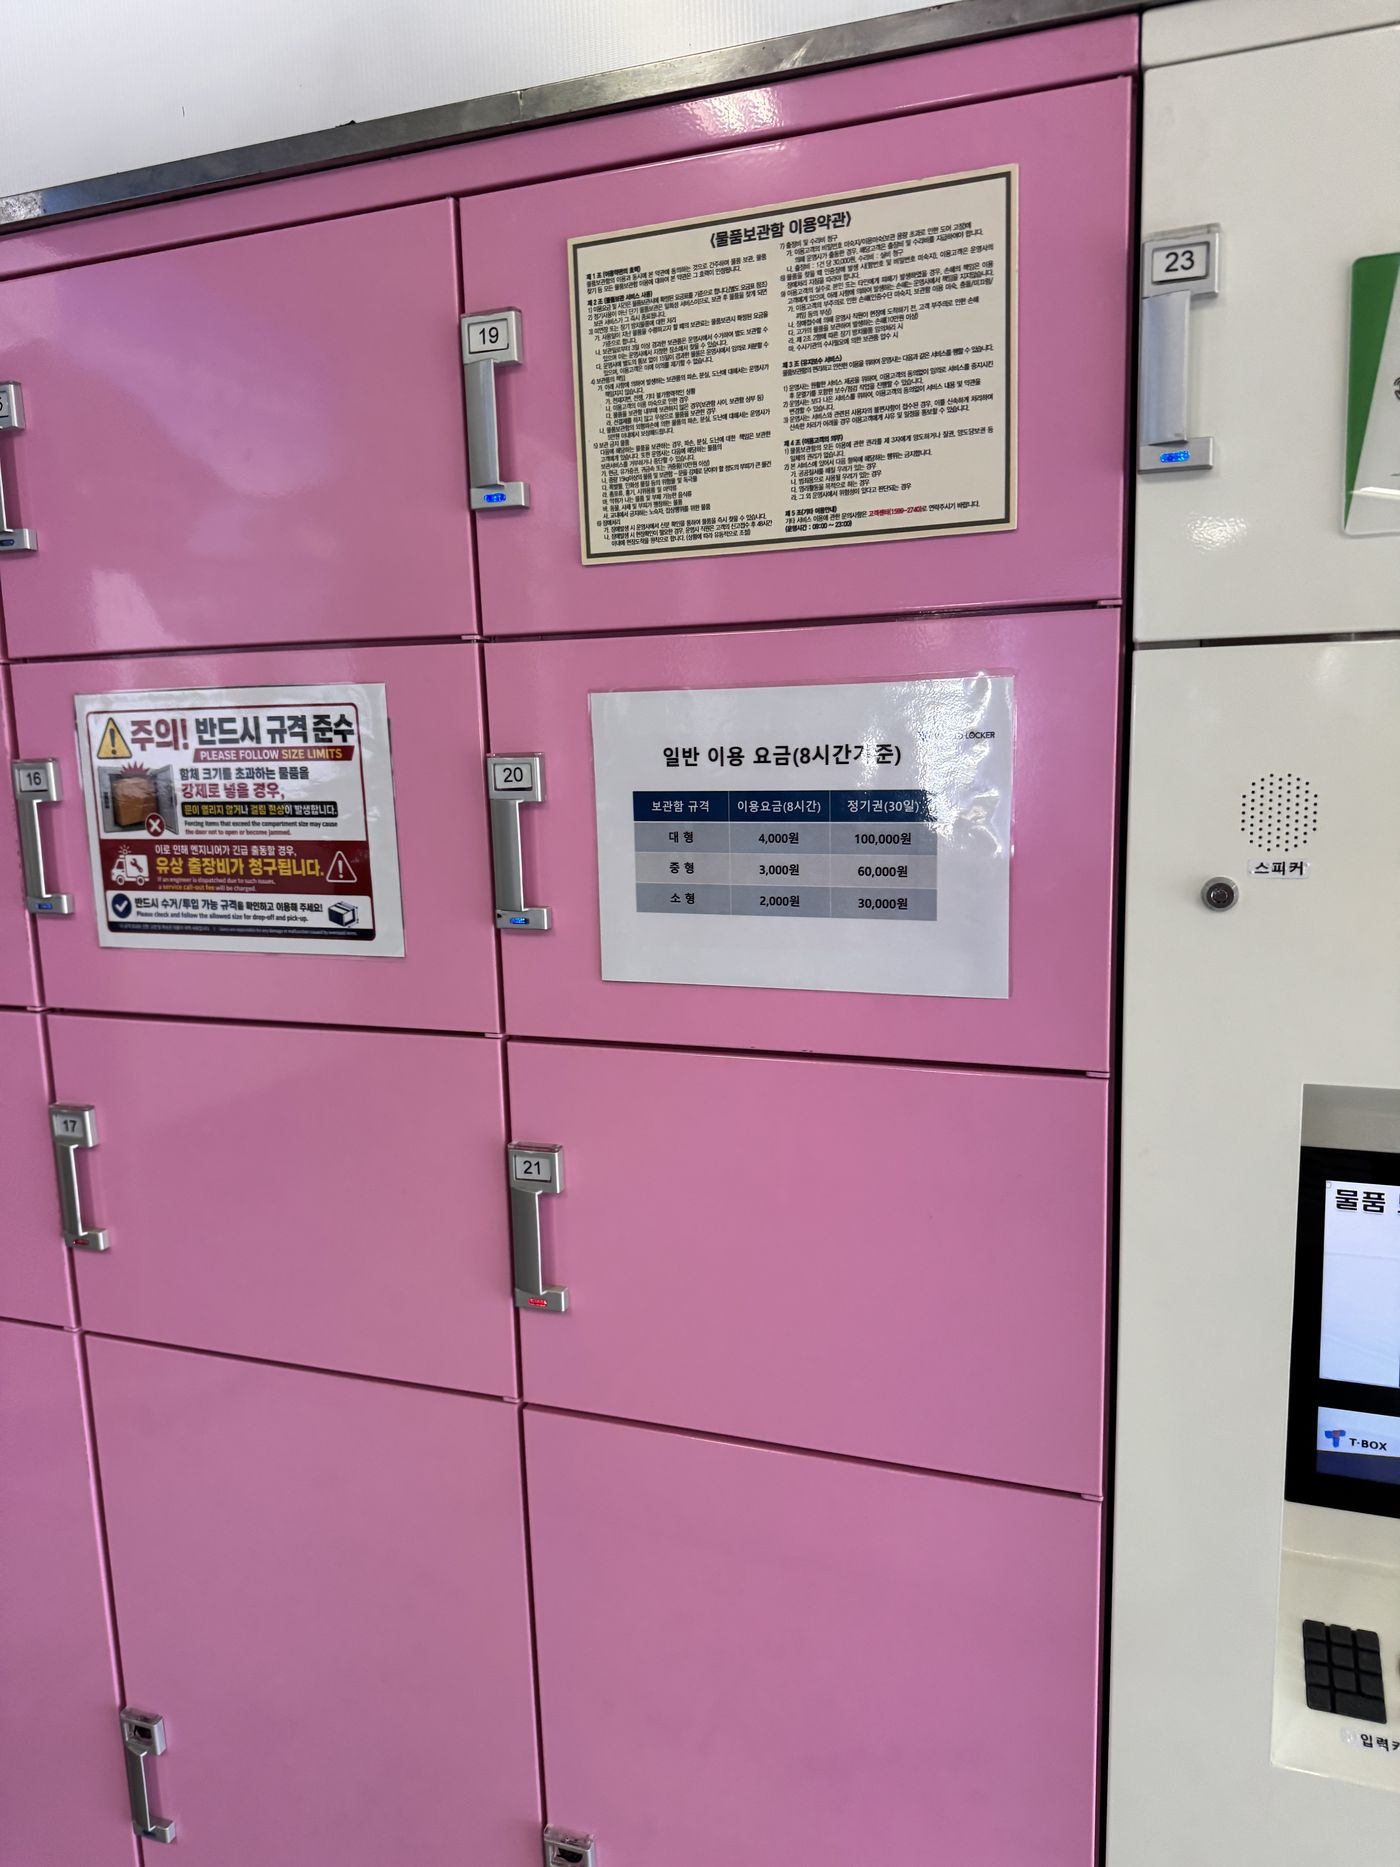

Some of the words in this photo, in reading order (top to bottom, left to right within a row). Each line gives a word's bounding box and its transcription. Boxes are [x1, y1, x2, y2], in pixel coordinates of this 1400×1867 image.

[1165, 250, 1195, 272] 23
[480, 326, 499, 346] 19
[131, 718, 188, 751] 주의!
[195, 716, 262, 745] 반드시
[267, 715, 307, 744] 규격
[312, 714, 354, 743] 준수
[966, 731, 996, 740] LOCKER
[200, 749, 238, 760] PLEASE
[239, 749, 279, 760] FOLLOW
[282, 749, 305, 760] SIZE
[307, 748, 343, 759] LIMITS
[663, 747, 700, 767] 일반
[708, 746, 745, 766] 이용
[26, 771, 42, 787] 16
[179, 767, 201, 781] 함체
[202, 767, 232, 780] 크기를
[234, 766, 276, 780] 초과하는
[278, 766, 309, 780] 물품을
[503, 766, 523, 784] 20
[180, 783, 220, 799] 강제로
[223, 783, 249, 798] 넣을
[252, 782, 284, 798] 경우,
[183, 805, 199, 814] 문이
[201, 805, 224, 814] 열리지
[225, 805, 248, 814] 않거나
[250, 804, 266, 814] 걸림
[268, 804, 292, 814] 현상이
[294, 804, 337, 814] 발생합니다.
[651, 801, 683, 813] 보관함
[687, 801, 710, 813] 규격
[737, 800, 821, 814] 이용요금(8시간)
[847, 799, 920, 814] 정기권(30일)
[758, 832, 800, 845] 4,000원
[854, 832, 911, 846] 100,000원
[155, 845, 170, 854] 이로
[172, 845, 188, 855] 인해
[190, 845, 230, 855] 엔지니어가
[232, 845, 248, 855] 긴급
[250, 845, 276, 855] 출동할
[277, 845, 296, 856] 경우,
[155, 856, 184, 874] 유상
[187, 857, 244, 875] 출장비가
[248, 857, 324, 876] 청구됩니다.
[759, 863, 800, 876] 3,000원
[857, 864, 908, 878] 60,000원
[1254, 861, 1304, 876] 스피커
[134, 897, 158, 908] 반드시
[161, 898, 199, 909] 수거/투입
[201, 899, 218, 909] 가능
[220, 899, 244, 910] 규격을
[245, 900, 274, 911] 확인하고
[275, 900, 297, 911] 이용해
[299, 901, 323, 912] 주세요!
[759, 894, 800, 907] 2,000원
[857, 896, 908, 910] 30,000원
[63, 1120, 77, 1133] 17
[522, 1160, 541, 1175] 21
[1336, 1189, 1386, 1213] 물품
